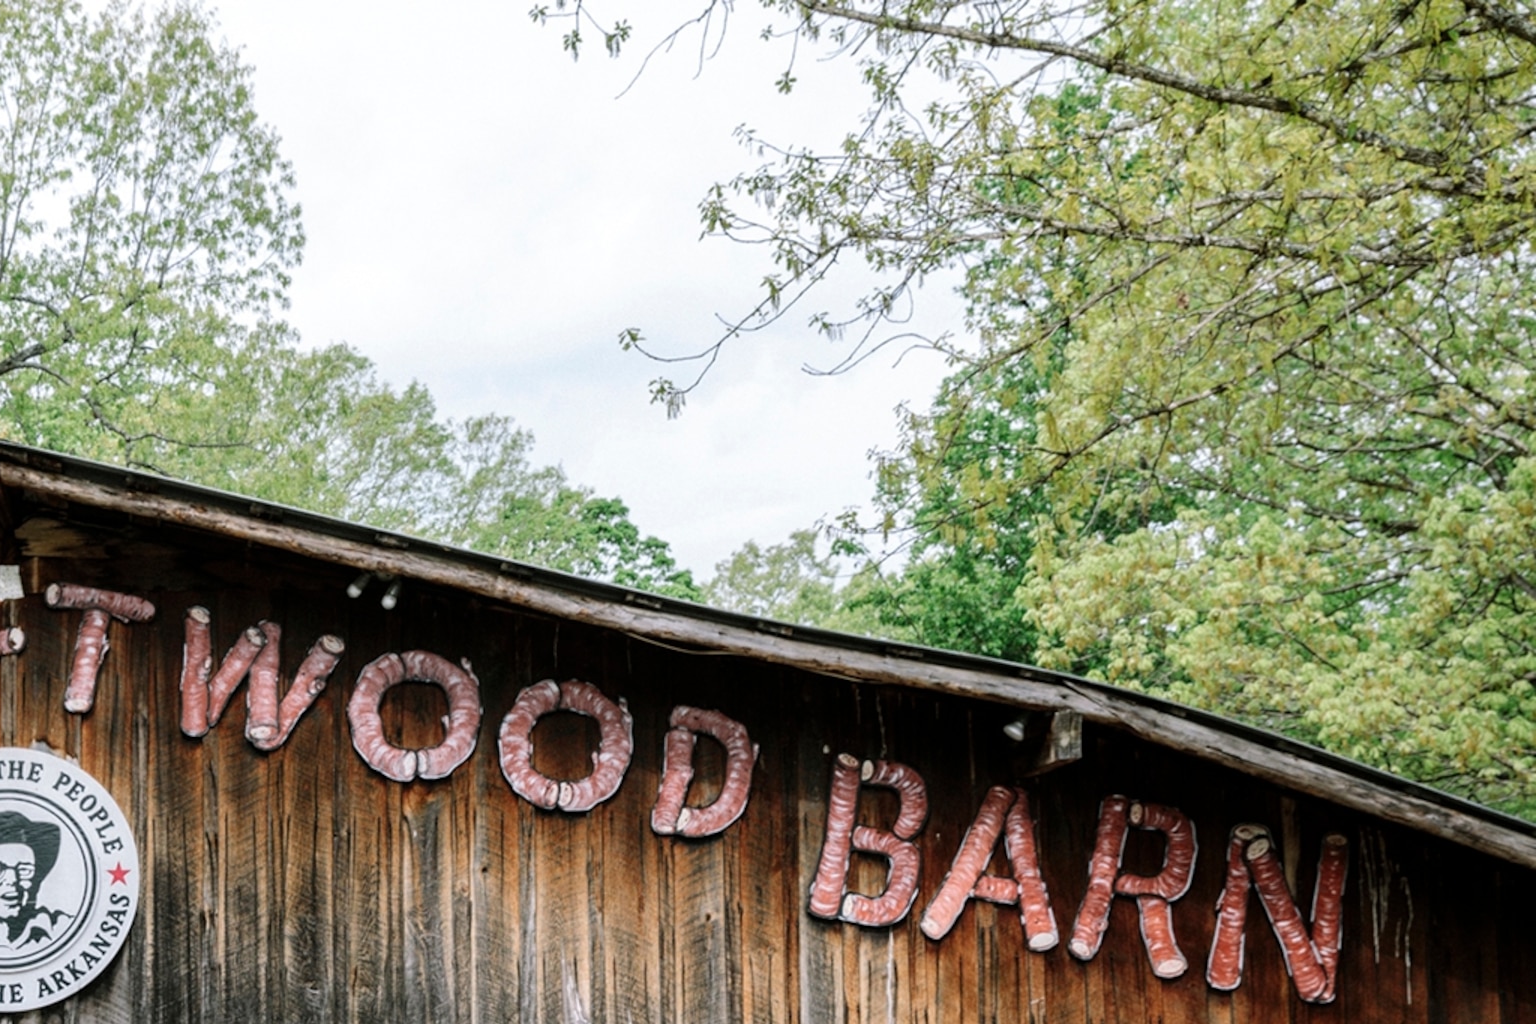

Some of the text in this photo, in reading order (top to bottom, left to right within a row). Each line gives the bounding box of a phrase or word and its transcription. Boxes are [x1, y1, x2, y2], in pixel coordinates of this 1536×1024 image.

[52, 772, 124, 855] PEOPLE
[808, 752, 1350, 1003] BARN
[37, 893, 131, 998] ARKANSAS
